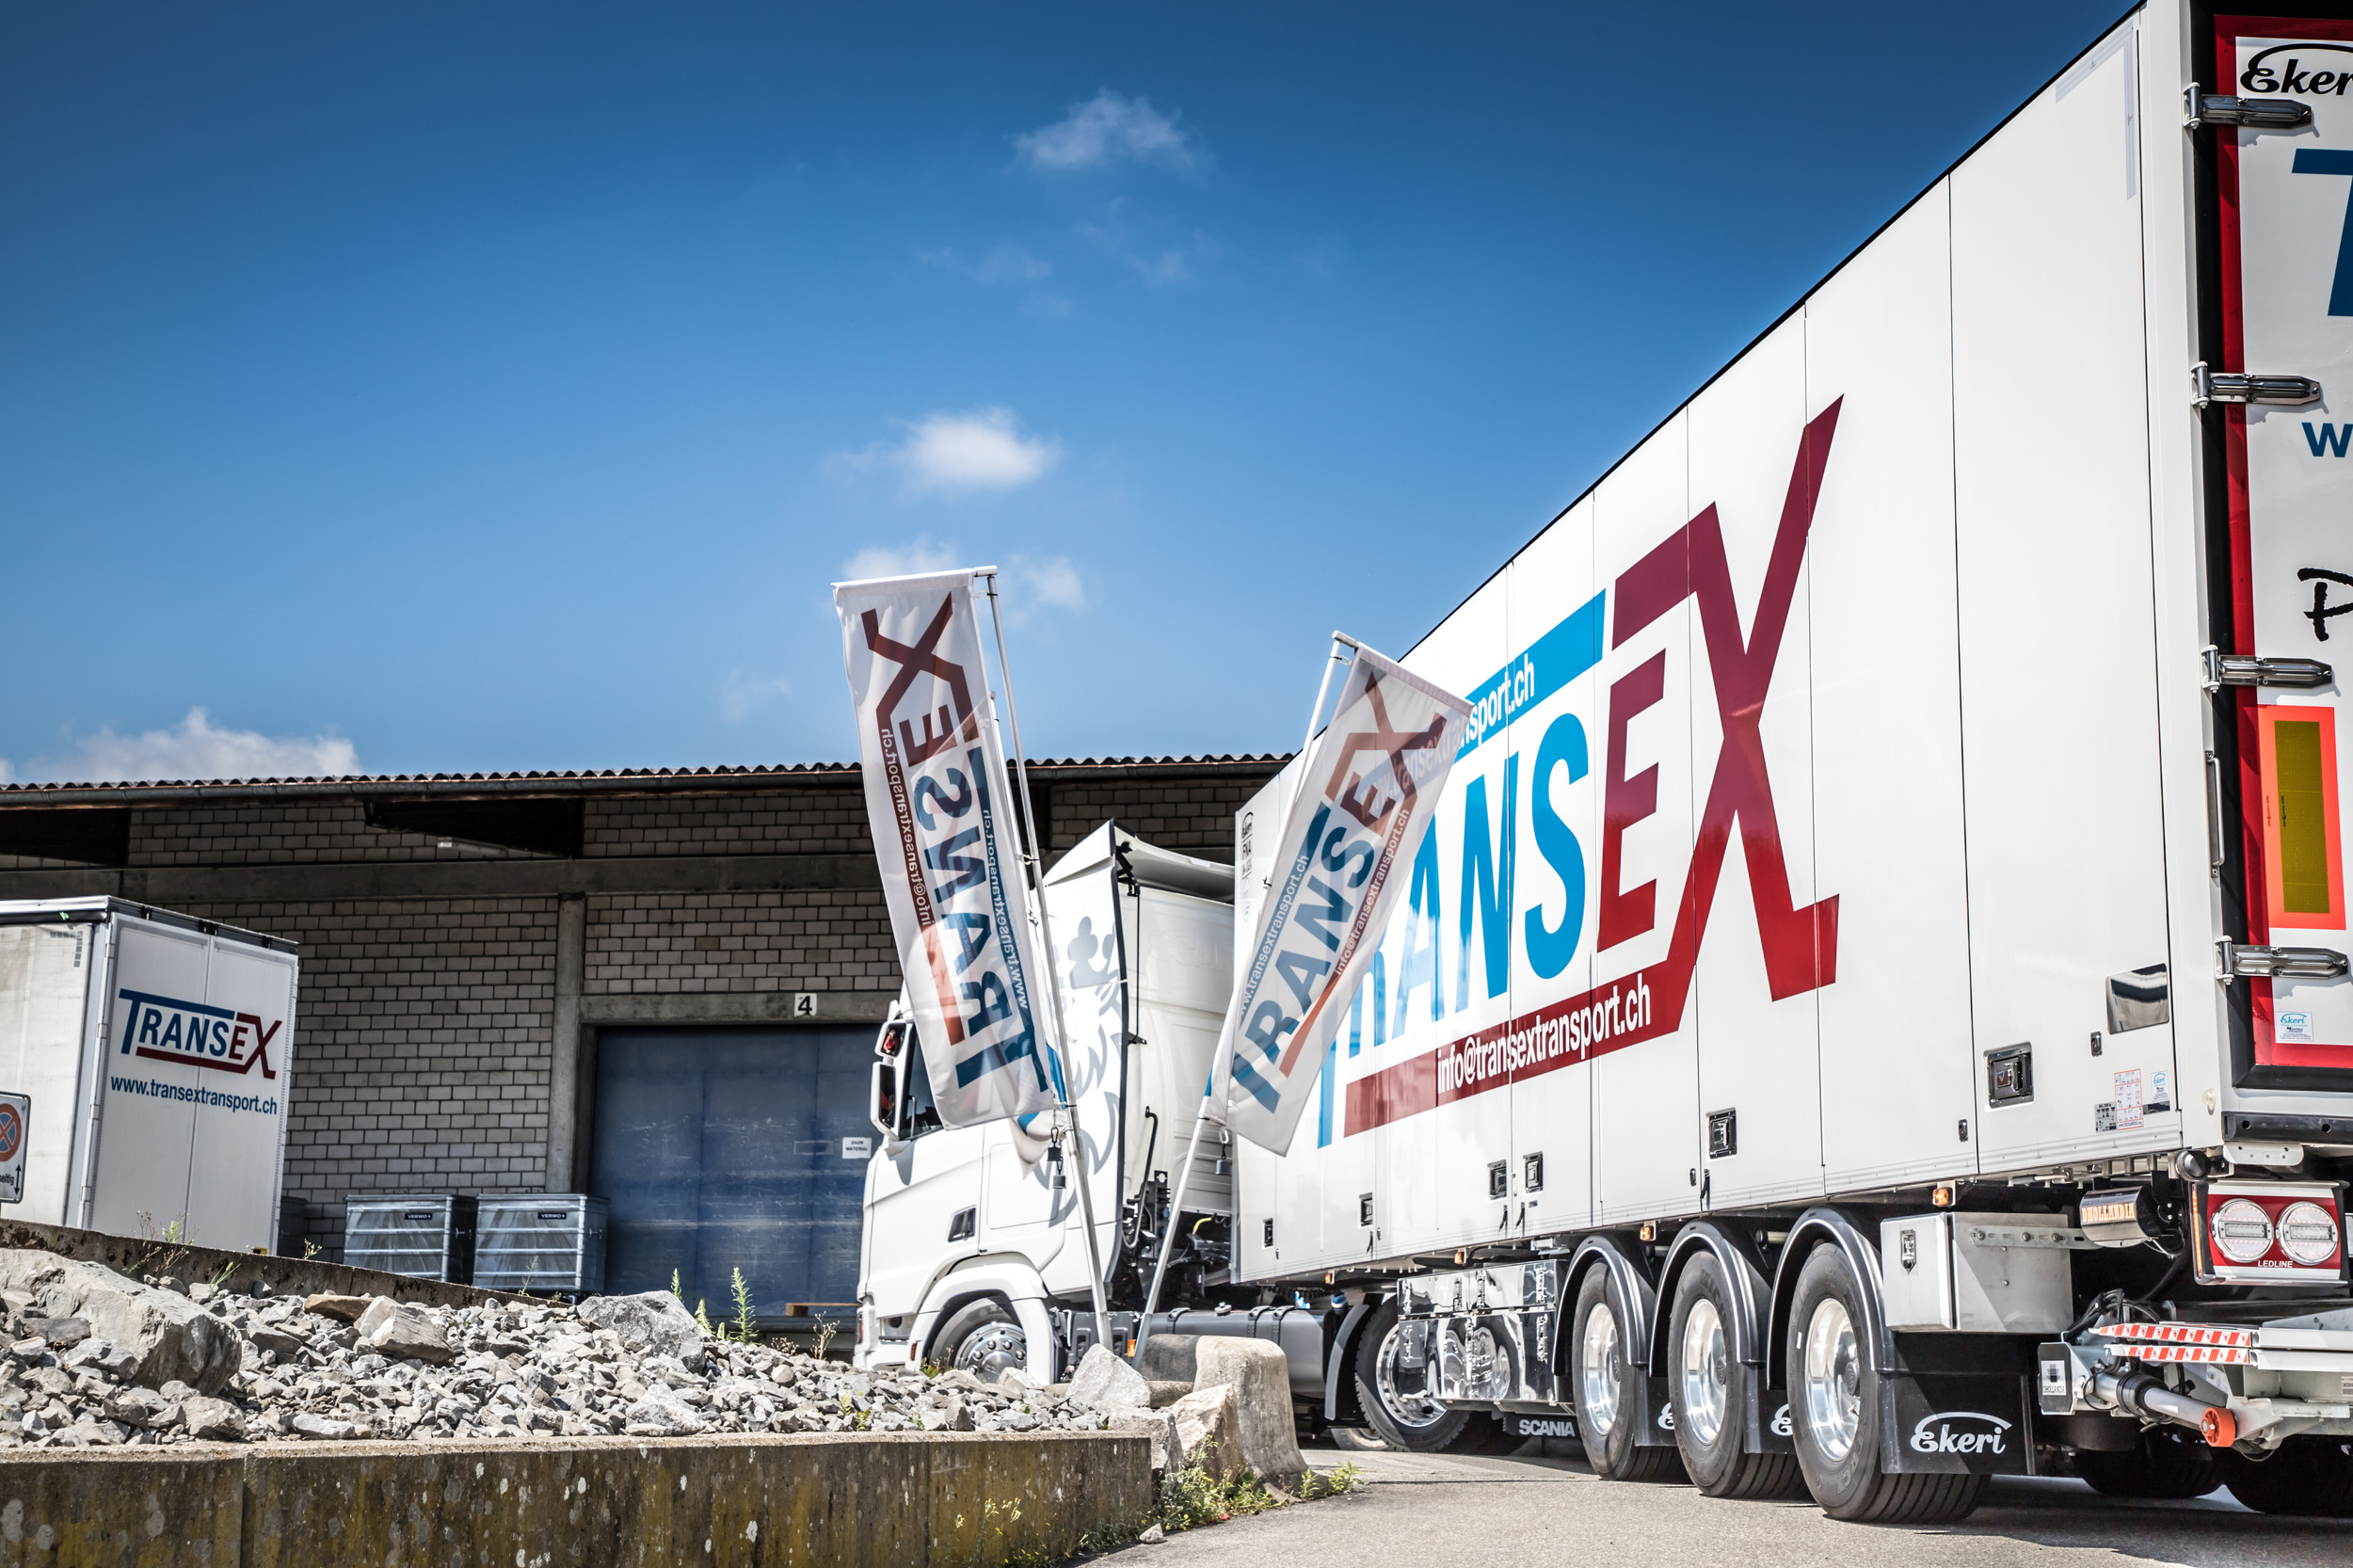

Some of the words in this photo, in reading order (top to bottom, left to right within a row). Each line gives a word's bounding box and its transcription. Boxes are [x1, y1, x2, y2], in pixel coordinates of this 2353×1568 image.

[1231, 671, 1448, 1114] TRANSEX
[1335, 808, 1410, 976] info@transextransport.ch
[798, 995, 812, 1015] 4
[119, 988, 282, 1080] TRANSEX
[1437, 972, 1651, 1095] info@transextransport.ch
[111, 1076, 278, 1114] www.transextransport.ch
[2081, 1202, 2137, 1224] DHOLLANDIA
[1518, 1418, 1576, 1437] SCANIA
[1910, 1412, 2012, 1454] Ekeri
